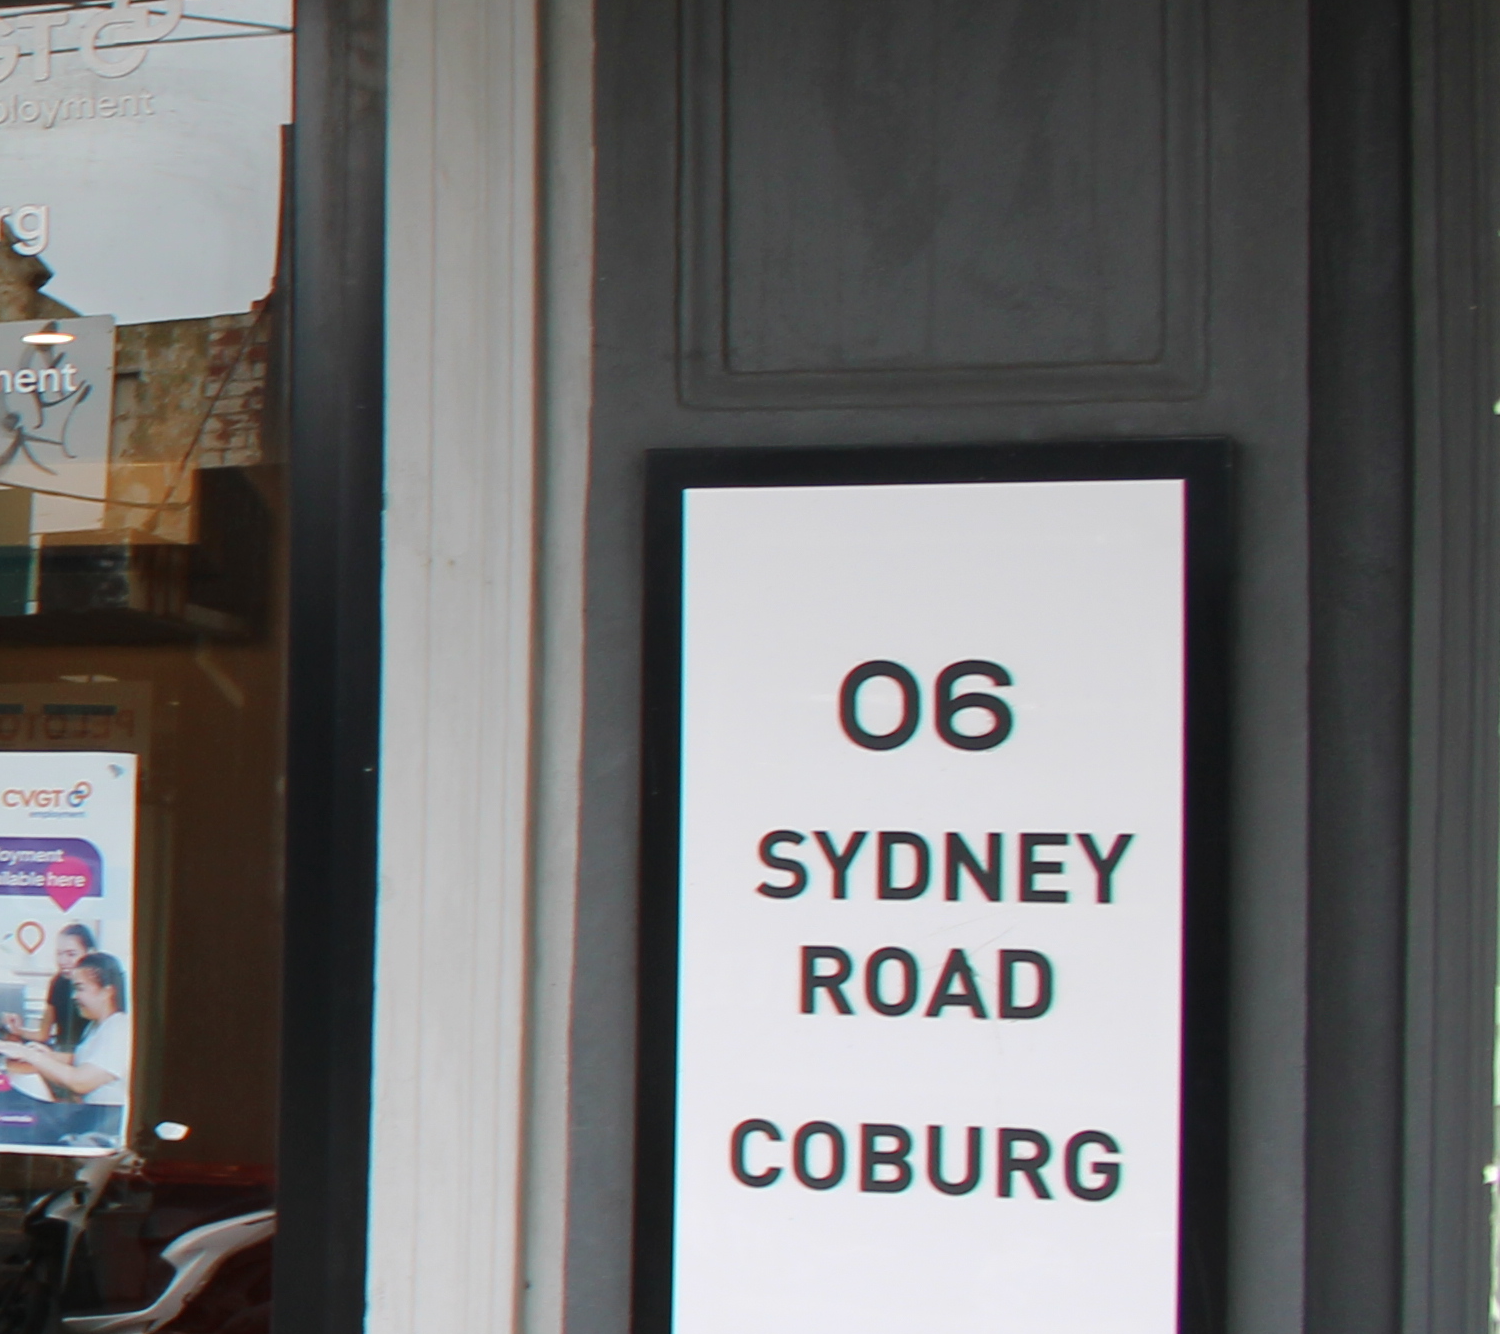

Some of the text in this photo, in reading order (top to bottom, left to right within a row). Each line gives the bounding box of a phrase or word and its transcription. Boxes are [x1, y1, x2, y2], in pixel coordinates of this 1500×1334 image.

[838, 658, 1016, 752] 06
[2, 789, 64, 808] CVGT
[47, 872, 86, 889] here
[755, 828, 1136, 905] SYDNEY
[798, 944, 1055, 1020] ROAD
[729, 1117, 1124, 1203] COBURG
